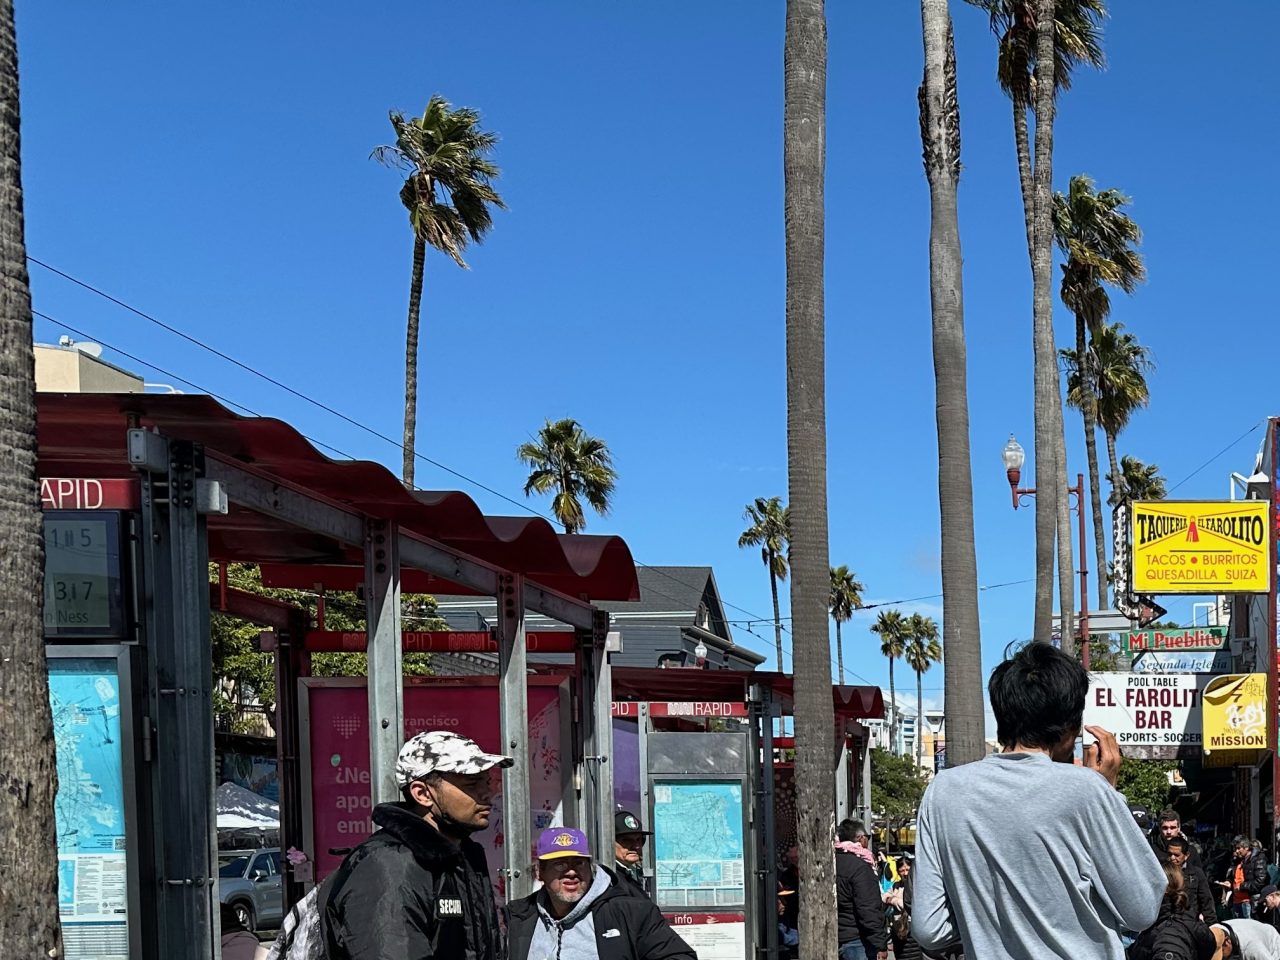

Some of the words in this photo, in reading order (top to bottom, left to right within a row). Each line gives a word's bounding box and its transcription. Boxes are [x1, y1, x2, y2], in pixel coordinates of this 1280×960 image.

[41, 479, 103, 510] APID
[1137, 513, 1188, 545] TAQUERIA
[1206, 515, 1264, 546] FAROLITO
[1146, 555, 1186, 565] TACOS
[1203, 554, 1258, 566] BURRITOS
[1146, 569, 1217, 580] QUESADILLA
[1226, 569, 1257, 580] SUIZA
[58, 609, 89, 623] Ness
[1129, 633, 1148, 650] Mi
[1154, 630, 1222, 649] Pueblito
[1128, 677, 1150, 687] POOL
[1152, 677, 1178, 687] TABLE
[1095, 688, 1117, 707] EL
[1126, 688, 1204, 708] FAROLIT
[610, 702, 630, 716] PID
[695, 702, 732, 716] RAPID
[404, 715, 459, 726] rancisco
[1135, 710, 1172, 729] BAR
[335, 767, 370, 784] ¿Ne
[335, 795, 371, 814] apo
[674, 914, 693, 924] info
